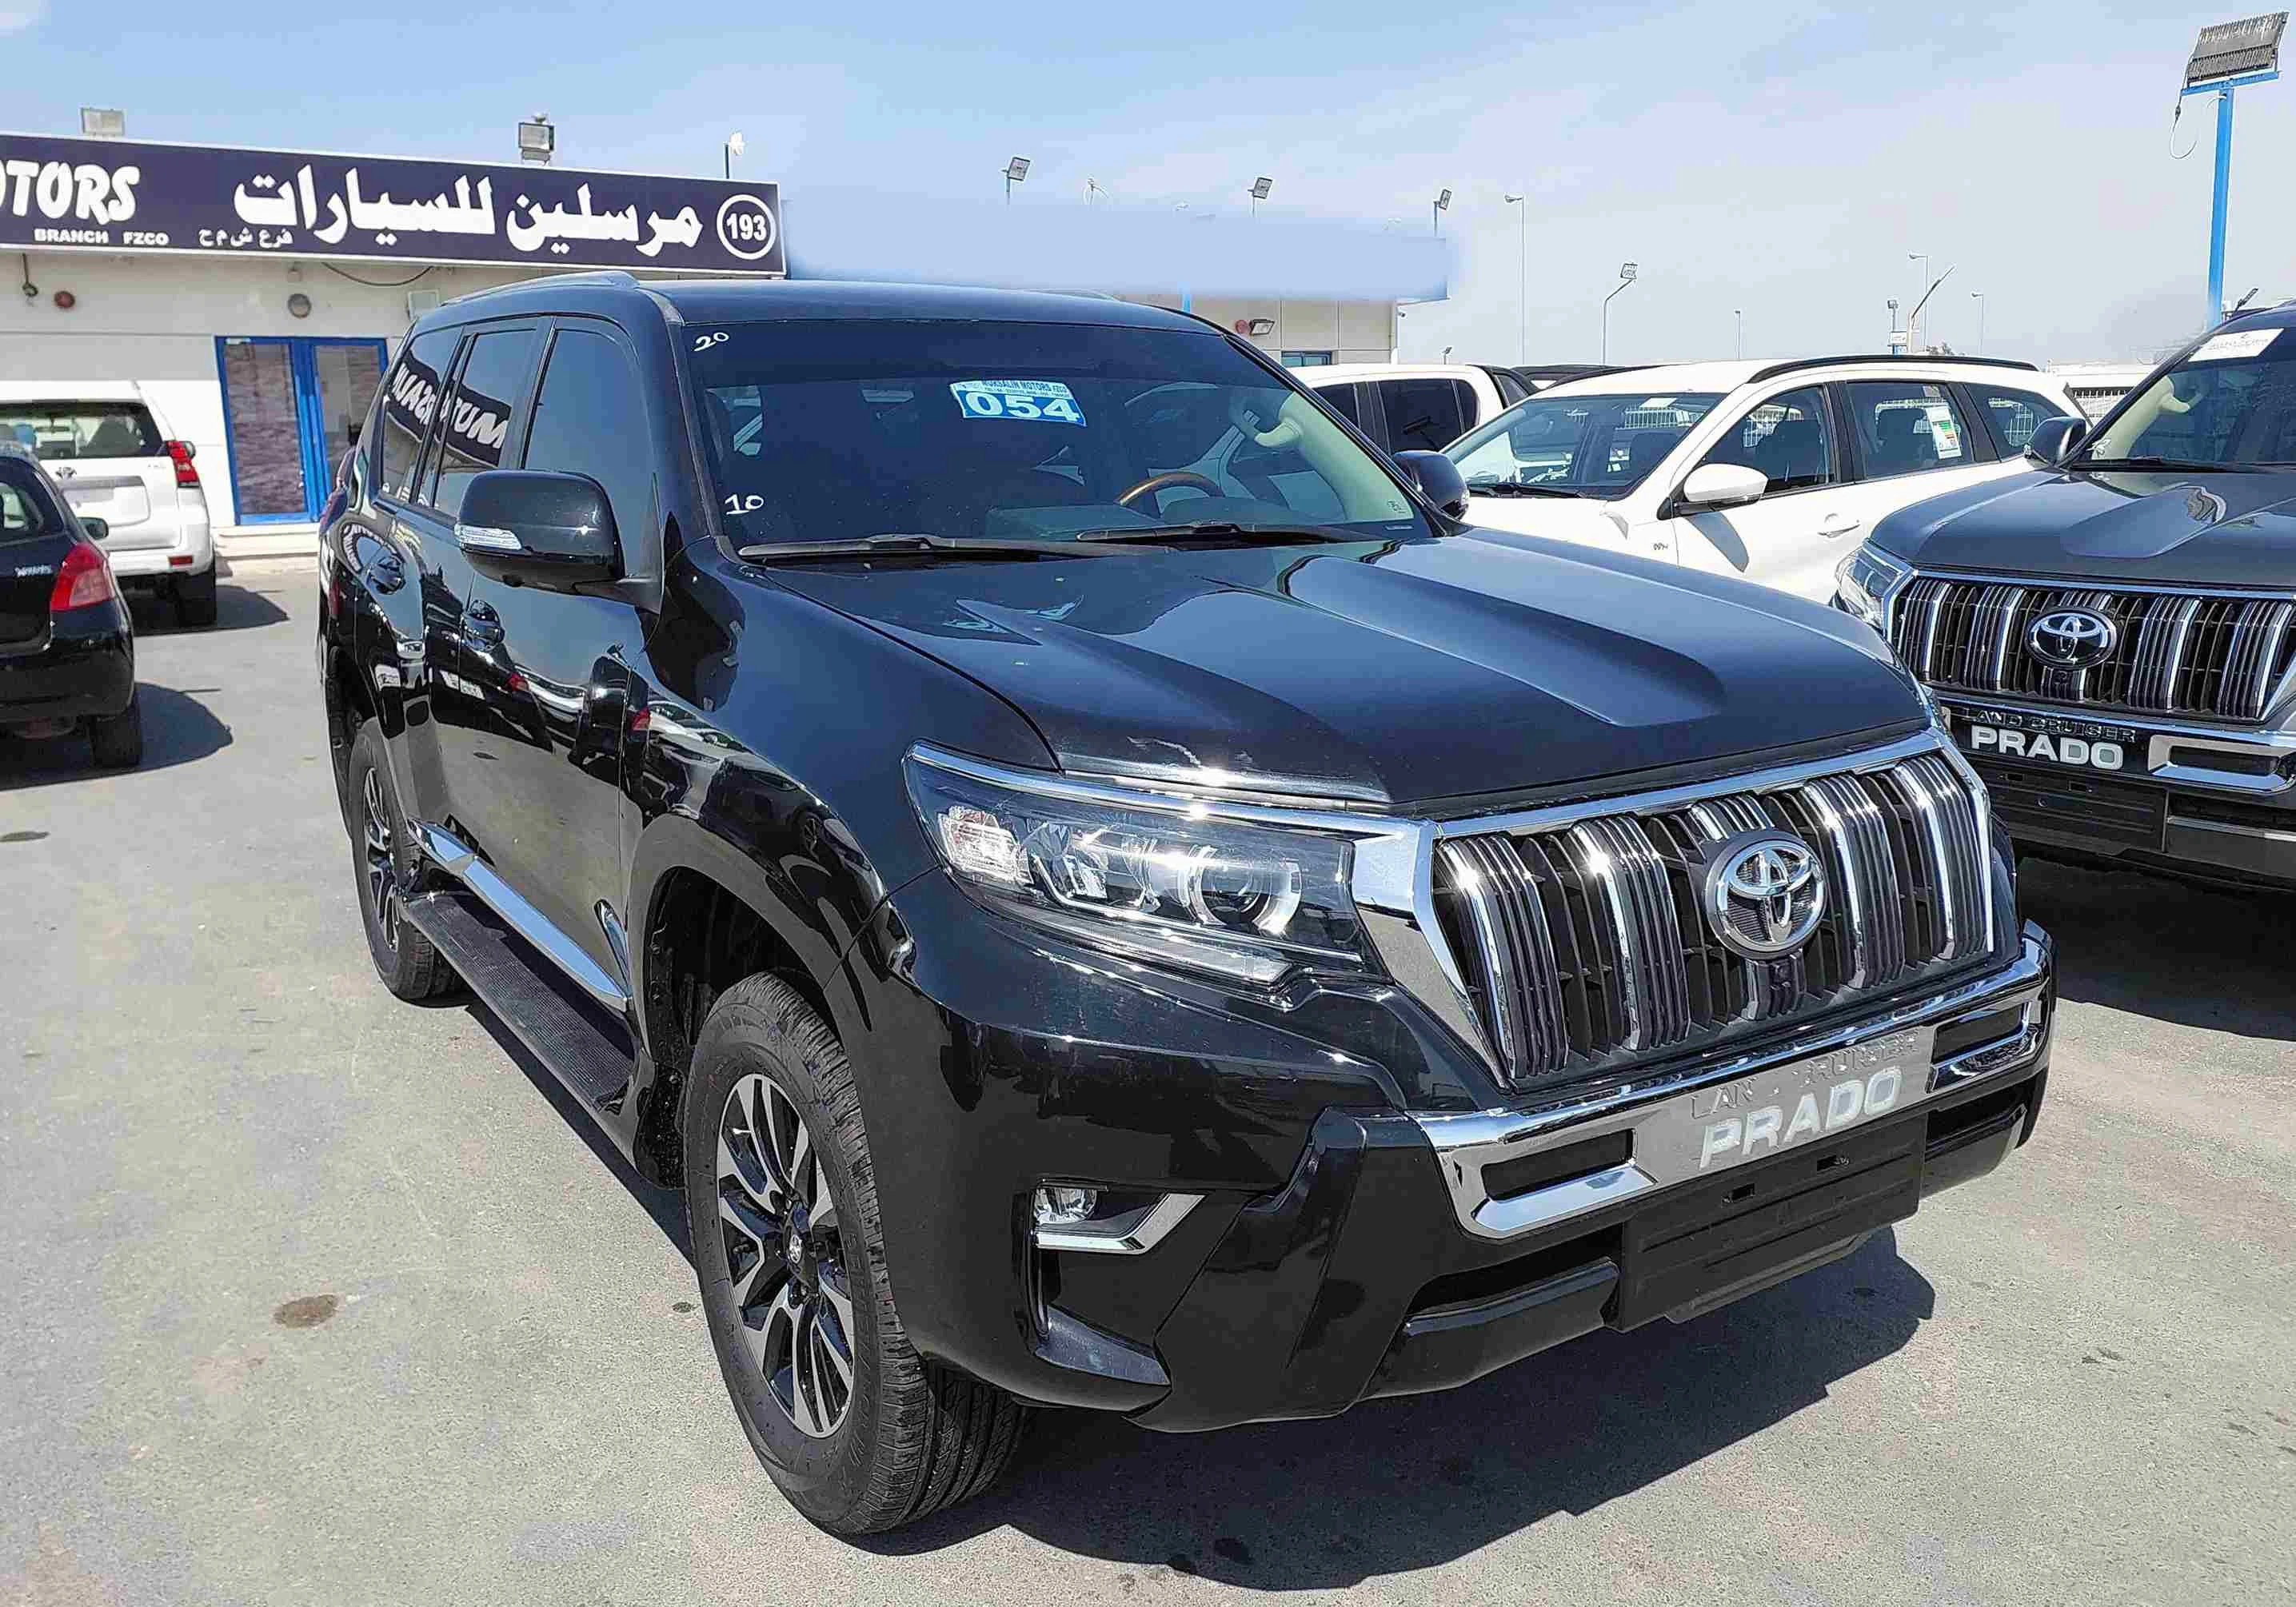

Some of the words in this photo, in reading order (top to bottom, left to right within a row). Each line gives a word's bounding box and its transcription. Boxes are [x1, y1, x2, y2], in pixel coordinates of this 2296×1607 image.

[0, 160, 141, 225] TORS
[234, 164, 496, 245] للسيارات
[506, 182, 704, 257] مرسلين
[726, 212, 766, 241] 193
[34, 228, 110, 244] BRANCH
[122, 230, 170, 246] FZCO
[259, 228, 293, 249] فرع
[693, 332, 729, 352] 20
[965, 392, 1081, 422] 054
[725, 494, 765, 516] 10
[1971, 724, 2124, 771] PRADO
[1699, 1065, 1903, 1170] PRADO
